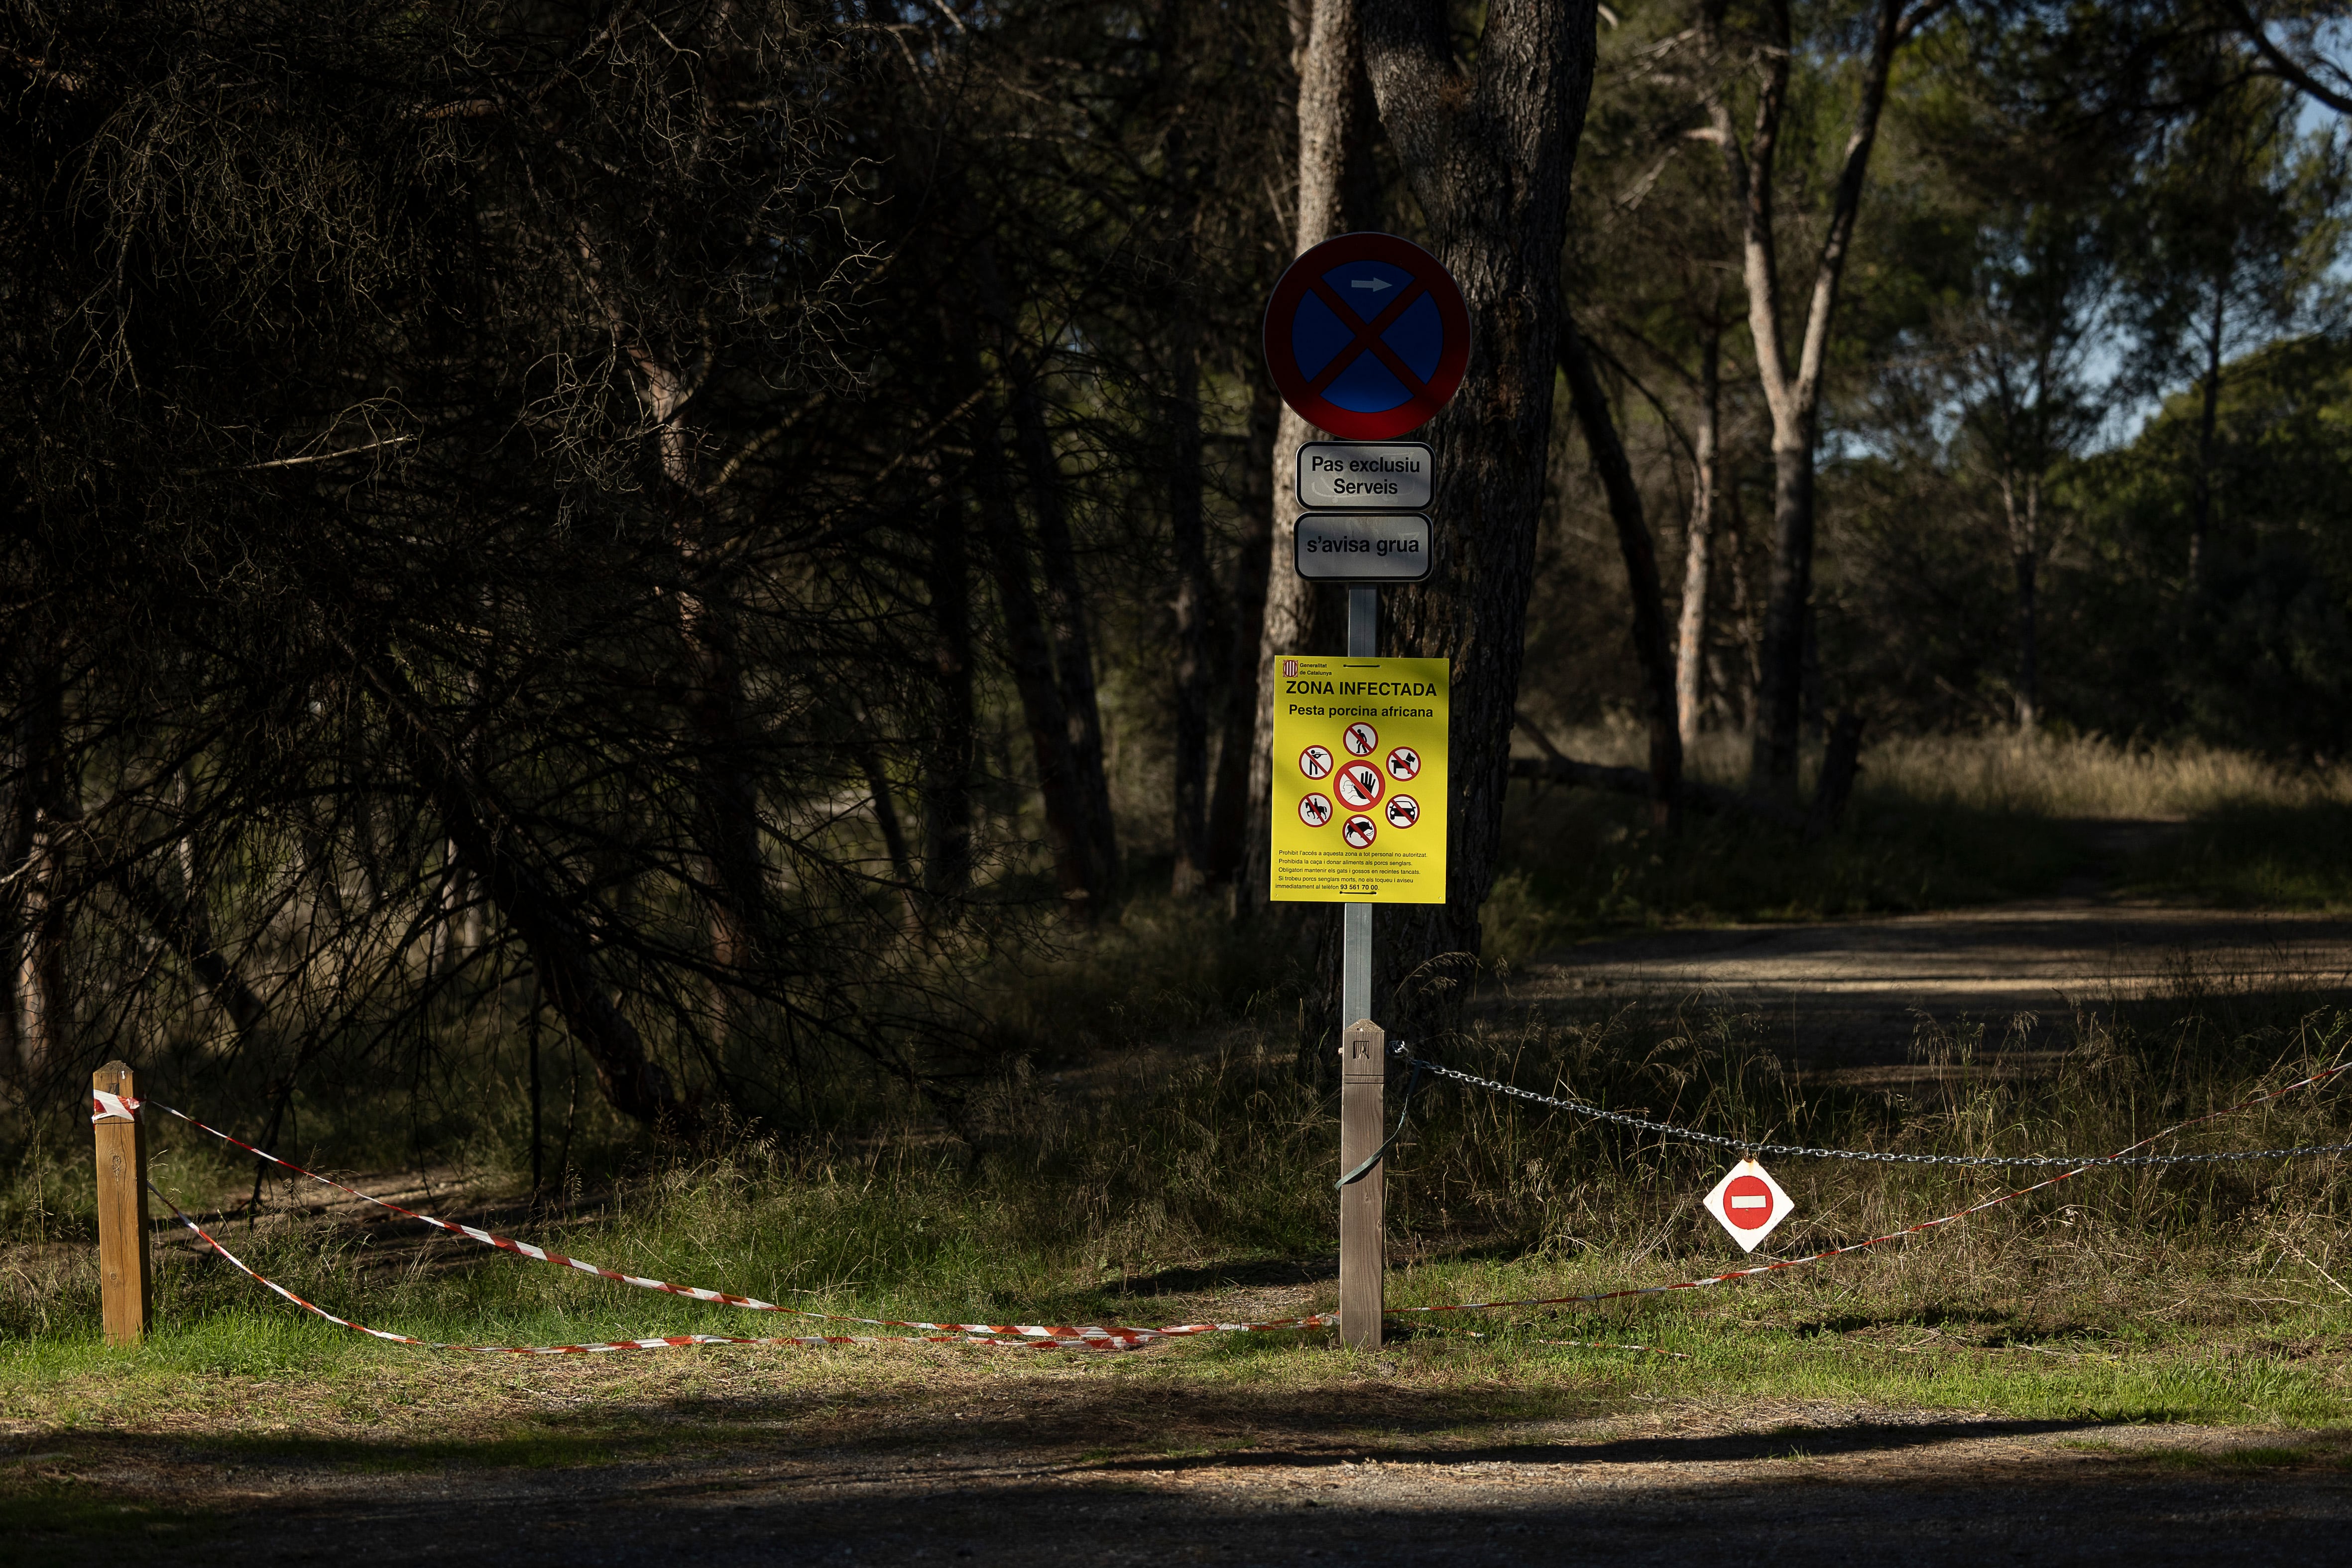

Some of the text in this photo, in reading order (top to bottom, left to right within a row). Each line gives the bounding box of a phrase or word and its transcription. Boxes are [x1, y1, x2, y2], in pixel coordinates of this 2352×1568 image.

[1312, 456, 1419, 473] Pas exclusiu
[1334, 478, 1398, 494] Serveis
[1307, 536, 1419, 556] s'avisa grua
[1286, 681, 1437, 696] ZONA INFECTADA
[1289, 704, 1433, 718] Pesta porcina africana
